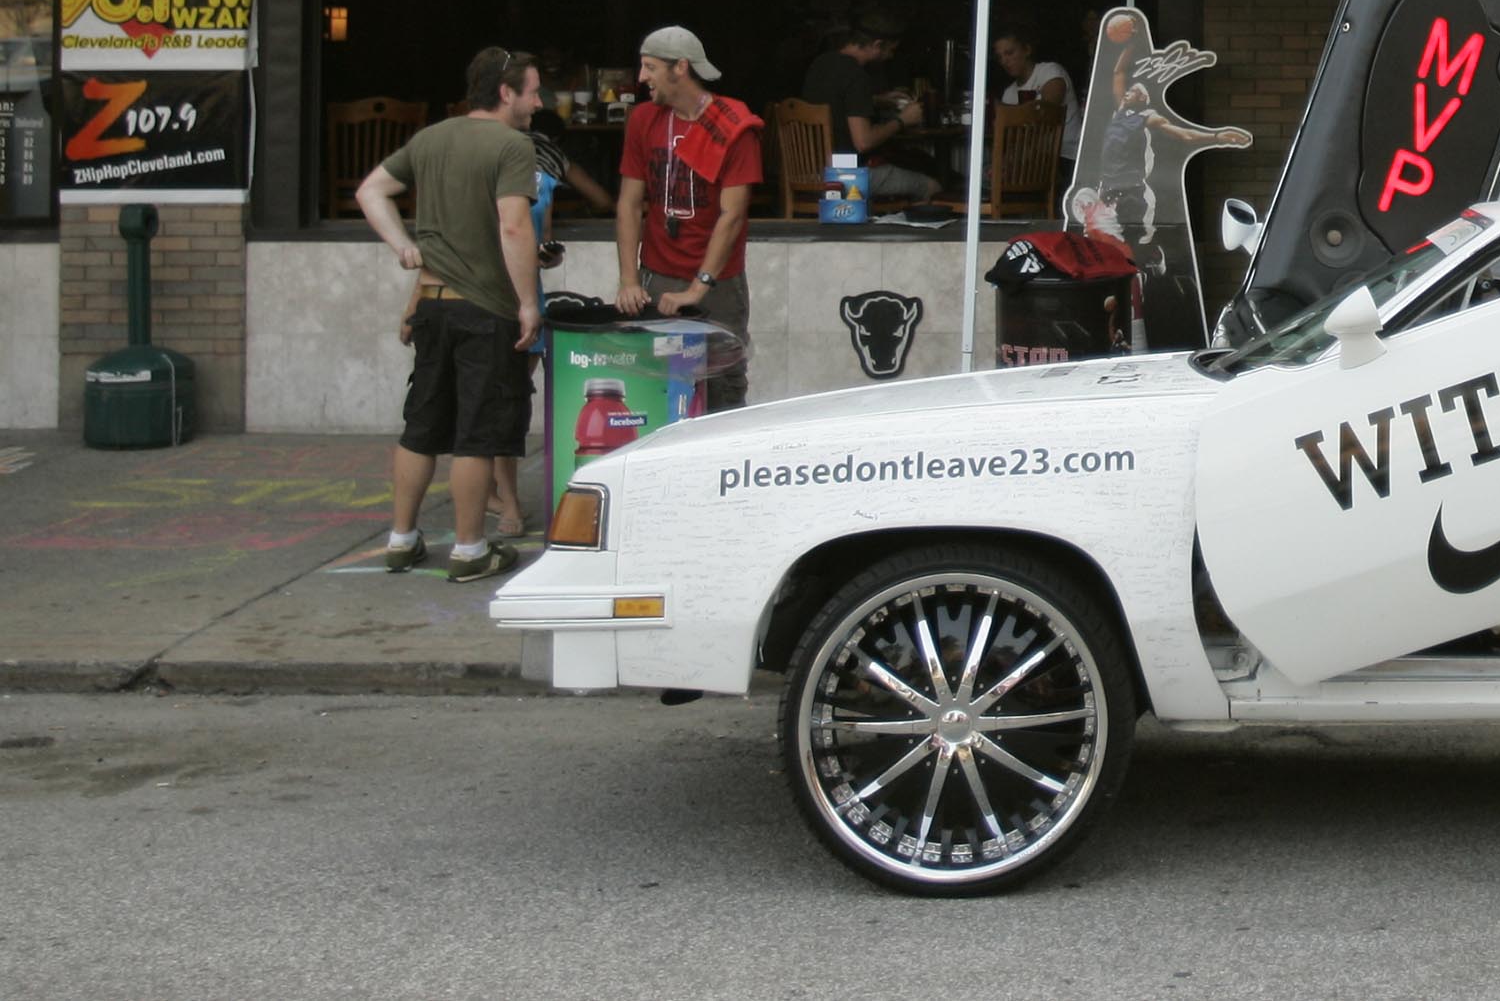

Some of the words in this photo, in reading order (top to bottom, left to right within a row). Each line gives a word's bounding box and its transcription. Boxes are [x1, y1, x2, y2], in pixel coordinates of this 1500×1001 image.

[61, 34, 156, 49] Cleveland's
[163, 35, 193, 48] R&B
[65, 77, 147, 160] Z
[126, 102, 197, 136] 107.9
[1377, 16, 1486, 213] MVP
[73, 147, 226, 185] ZHipHopCleveland.com
[609, 417, 645, 426] facebook
[719, 447, 1136, 497] pleasedontleave23.com
